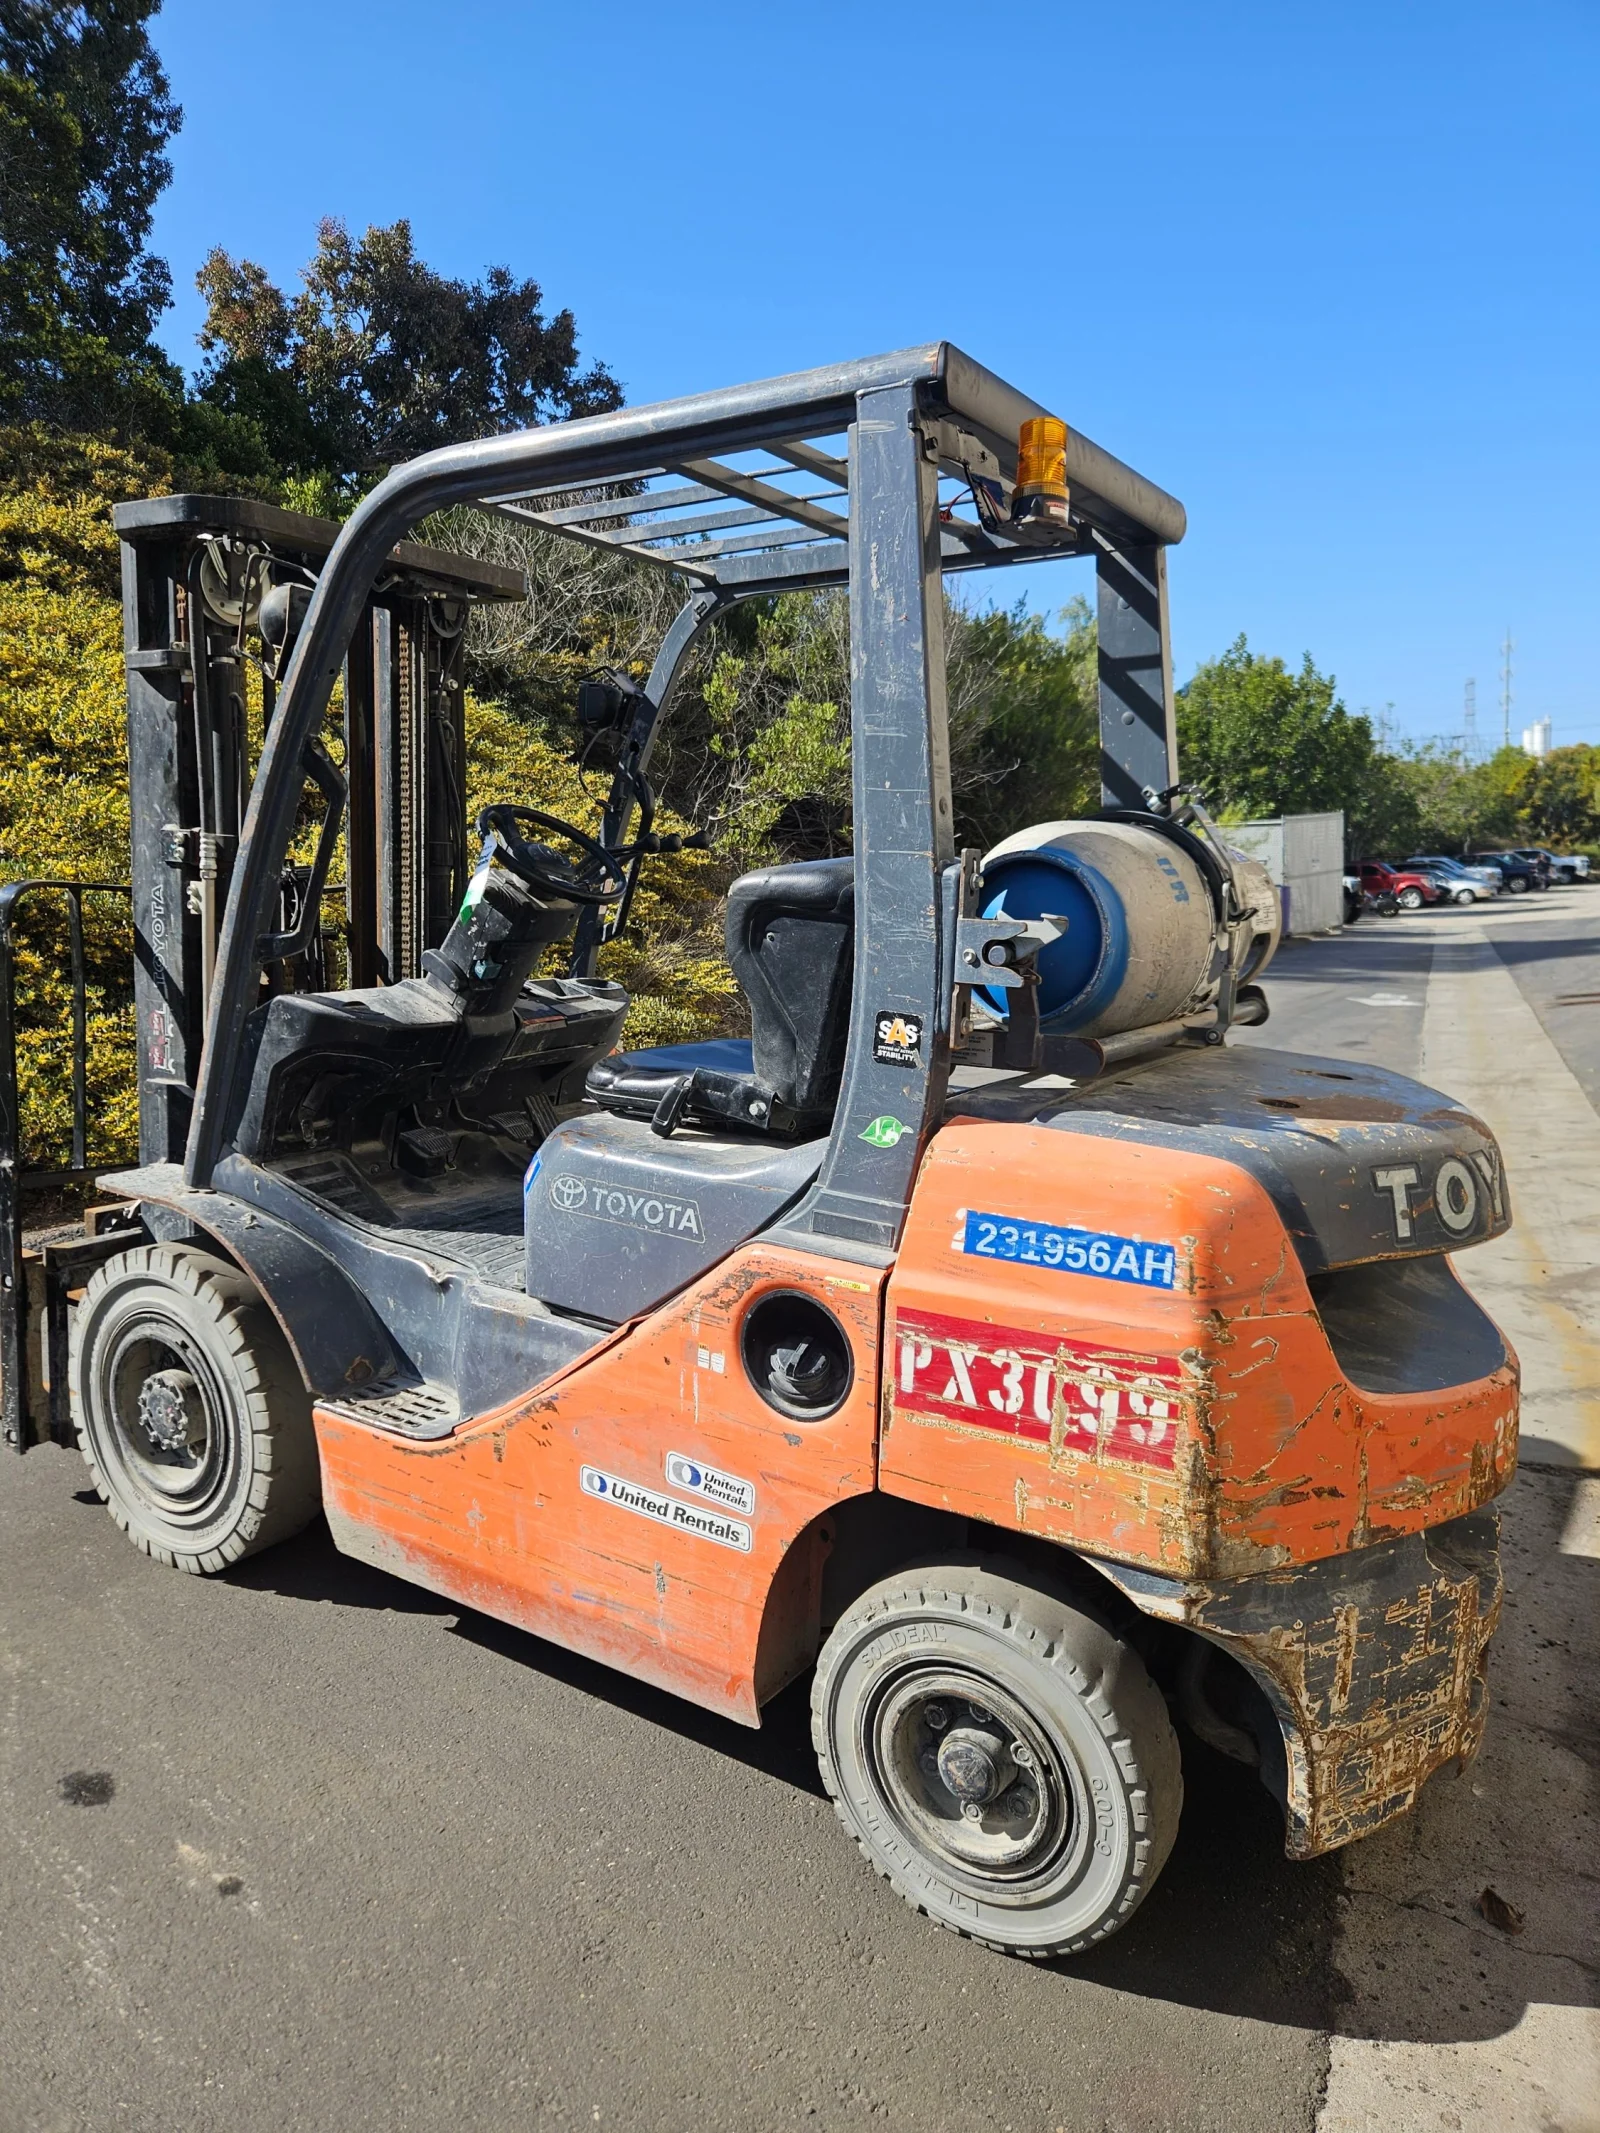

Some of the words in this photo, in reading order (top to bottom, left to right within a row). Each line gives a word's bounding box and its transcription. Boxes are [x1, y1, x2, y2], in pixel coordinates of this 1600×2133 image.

[151, 884, 166, 987] TOYOTA
[878, 1017, 918, 1047] SAS
[877, 1050, 915, 1062] STABILITY
[592, 1187, 699, 1235] TOYOTA
[975, 1221, 1174, 1285] 231956AH
[611, 1482, 669, 1518] United
[702, 1482, 748, 1509] Rentals
[703, 1471, 746, 1497] United
[672, 1506, 741, 1544] Rentals
[861, 1624, 947, 1669] SOLIDEAL
